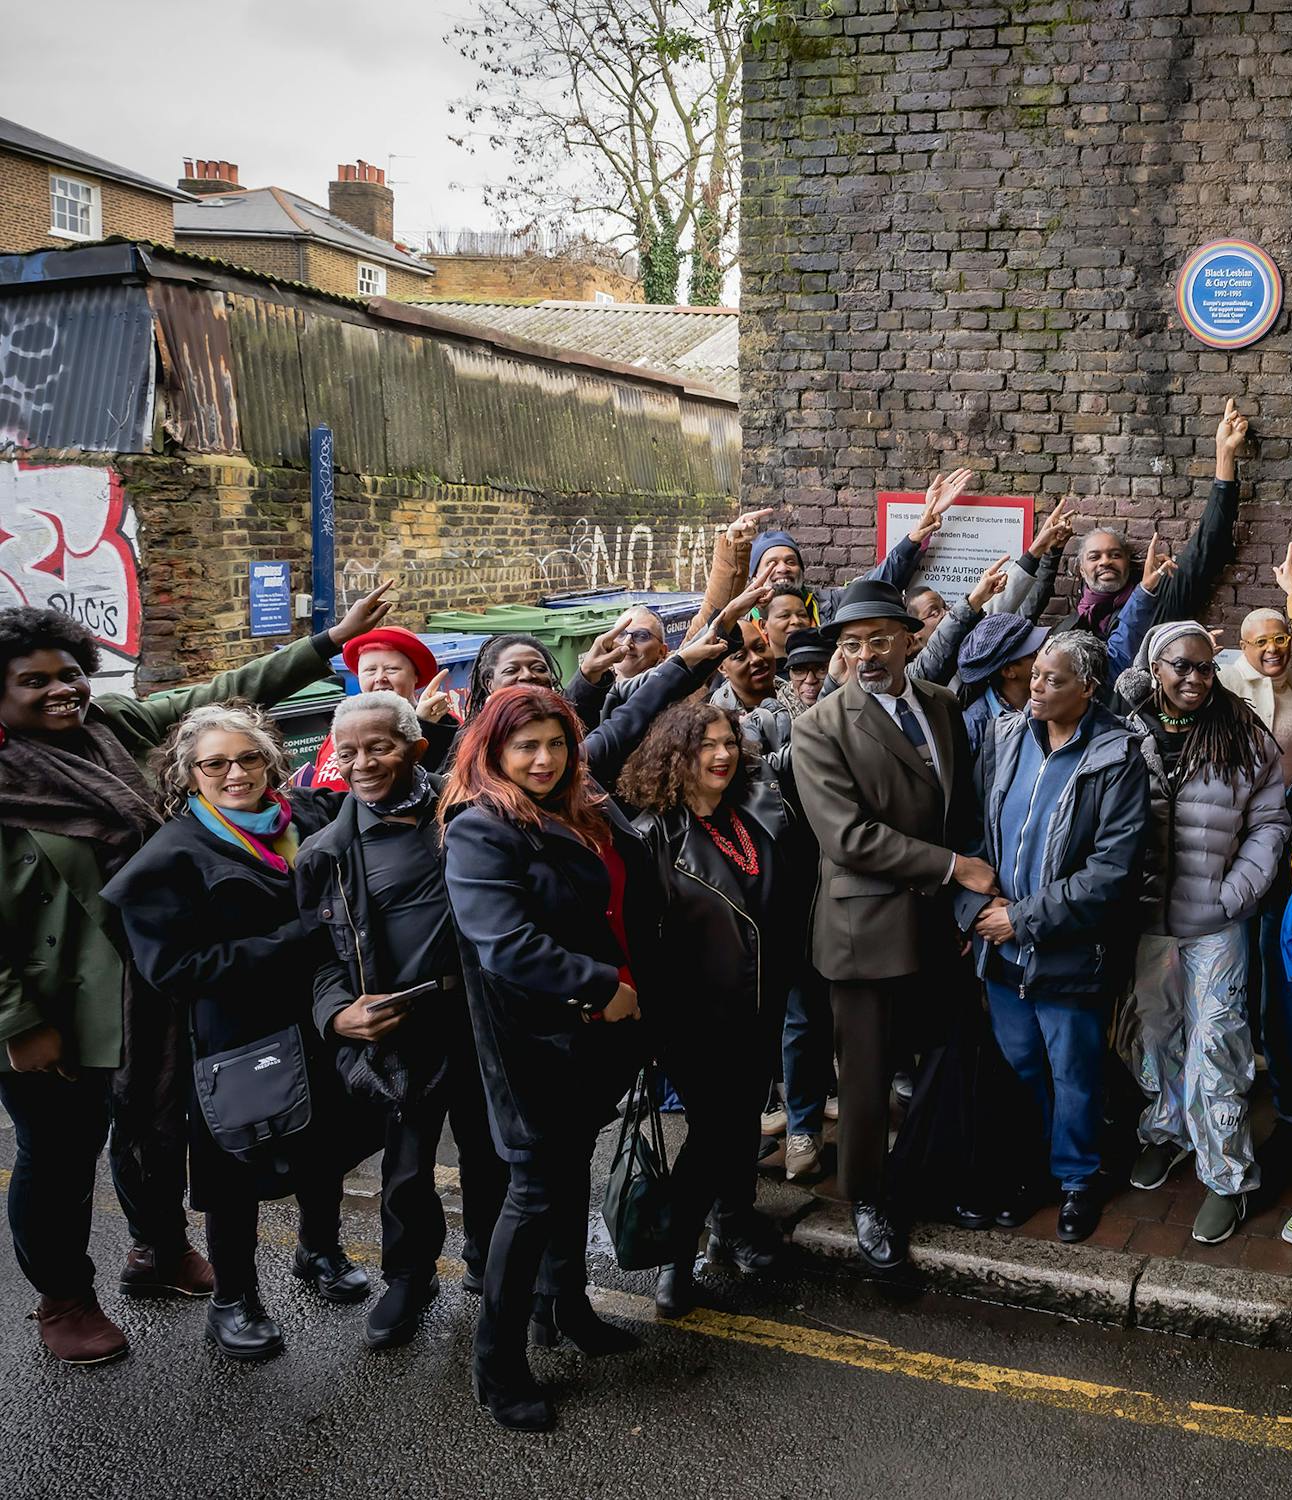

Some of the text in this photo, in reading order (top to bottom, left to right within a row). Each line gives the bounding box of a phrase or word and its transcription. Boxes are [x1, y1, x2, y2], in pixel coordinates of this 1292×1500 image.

[1205, 269, 1253, 277] Black Lesbian
[1205, 279, 1252, 288] & Gay Centre
[591, 524, 654, 590] NO
[924, 573, 940, 581] 020
[942, 574, 961, 582] 7928
[666, 619, 692, 635] GENERA
[299, 744, 322, 754] RECYC
